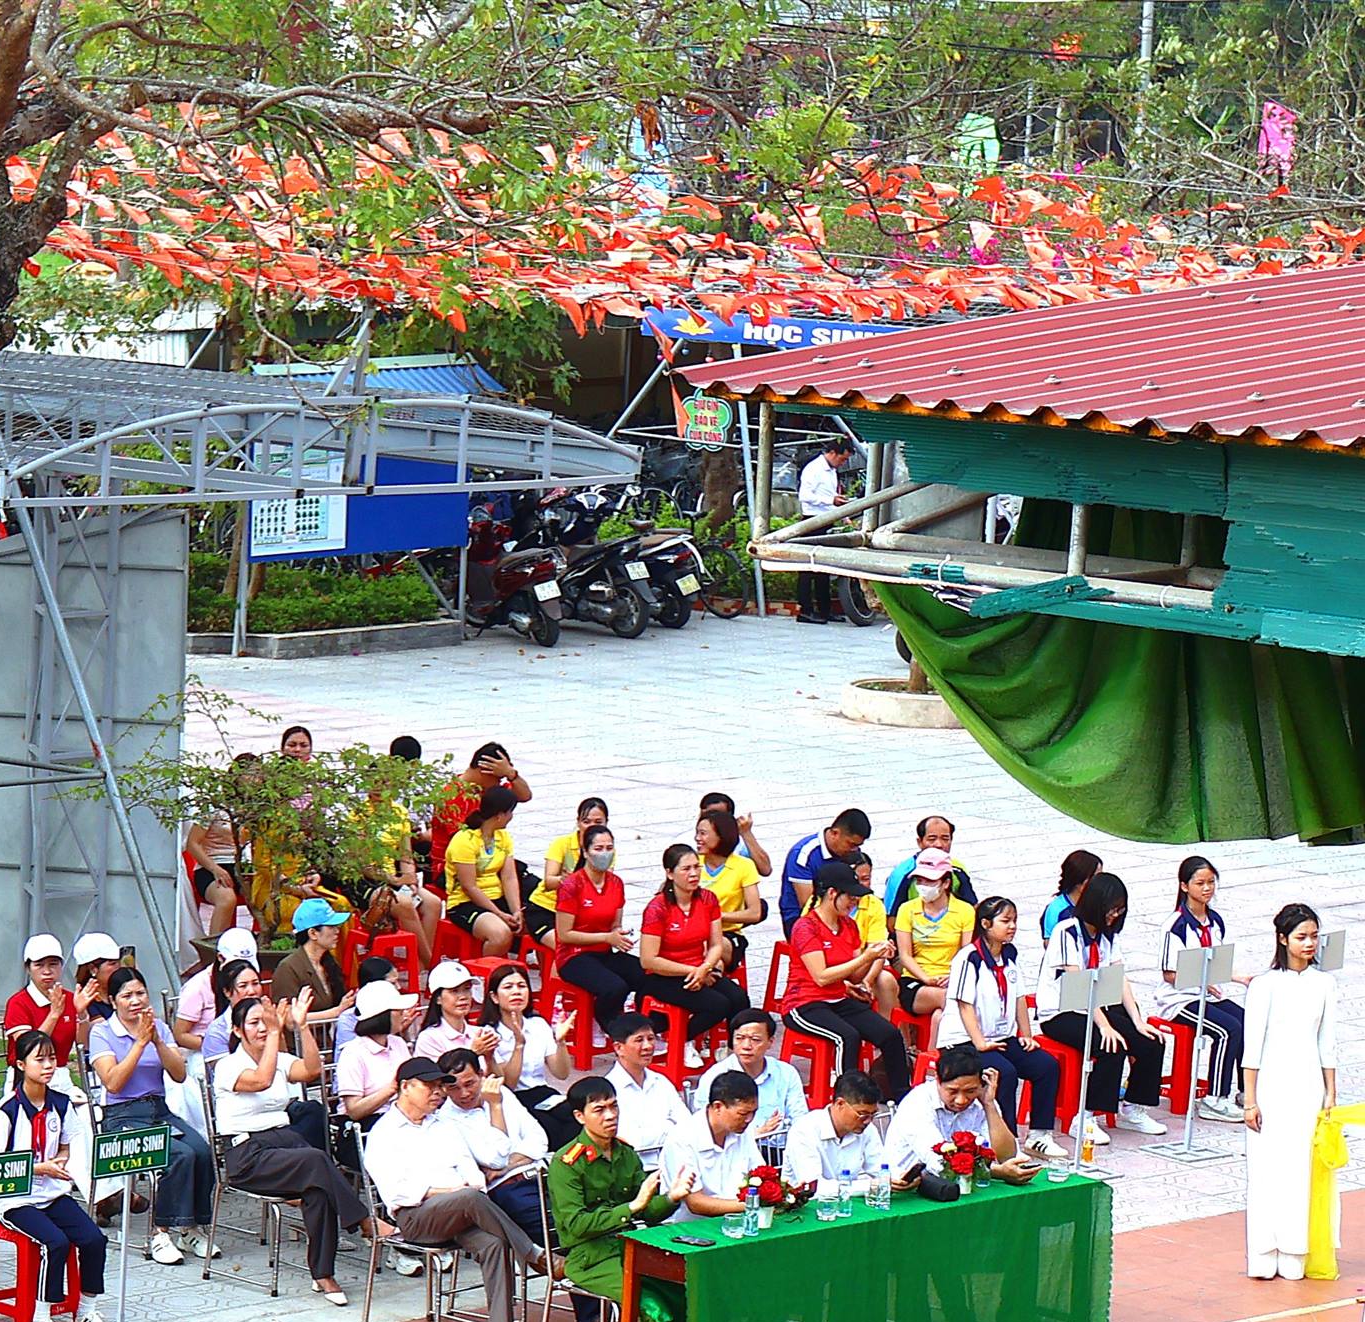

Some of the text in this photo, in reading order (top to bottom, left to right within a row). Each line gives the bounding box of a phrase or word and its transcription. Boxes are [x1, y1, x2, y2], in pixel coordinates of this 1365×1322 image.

[743, 322, 881, 345] HỌC SIN
[99, 1134, 165, 1159] KHỐI HỌC SINH
[3, 1160, 27, 1179] SINH
[109, 1156, 153, 1171] CỤM 1
[7, 1182, 15, 1192] 2
